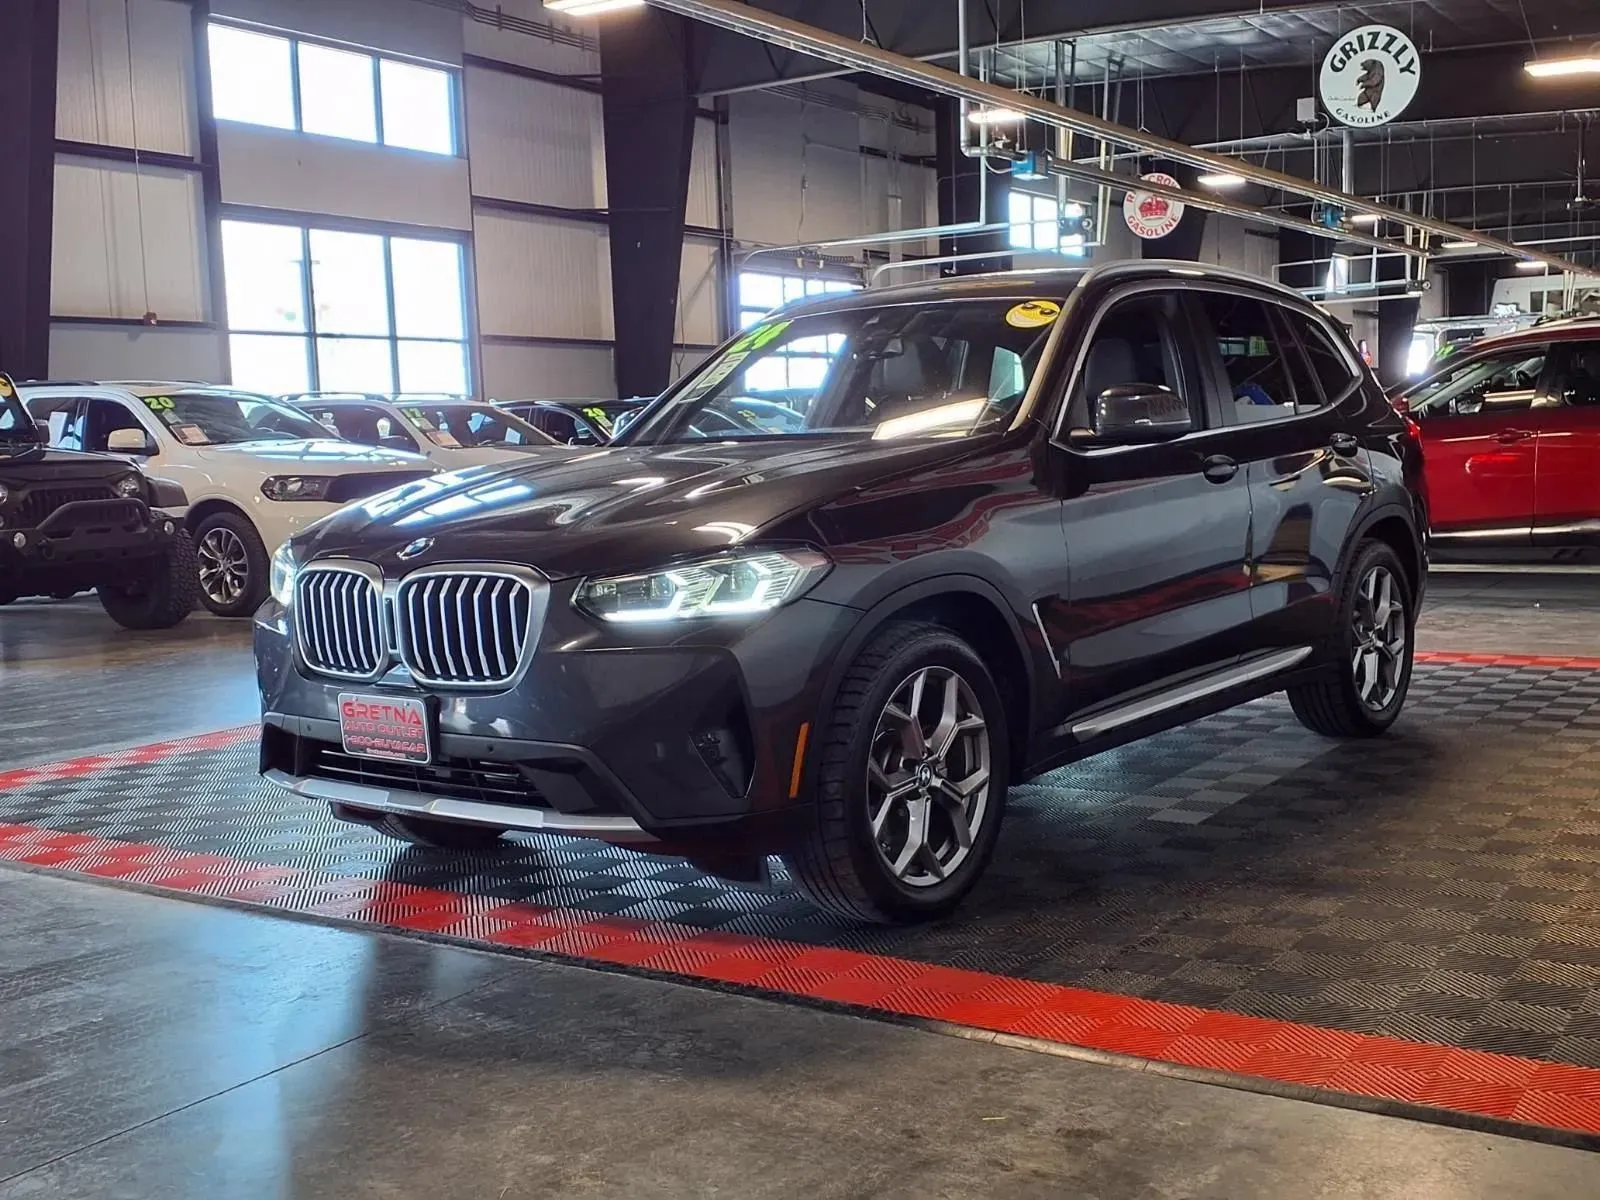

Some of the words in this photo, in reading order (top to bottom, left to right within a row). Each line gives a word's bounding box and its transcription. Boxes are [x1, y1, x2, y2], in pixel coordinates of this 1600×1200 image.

[1330, 31, 1416, 76] GRIZZLY
[1335, 107, 1391, 124] GASOLINE
[1127, 213, 1179, 237] GASOLINE
[144, 396, 176, 410] 20
[343, 702, 422, 725] GRETNA
